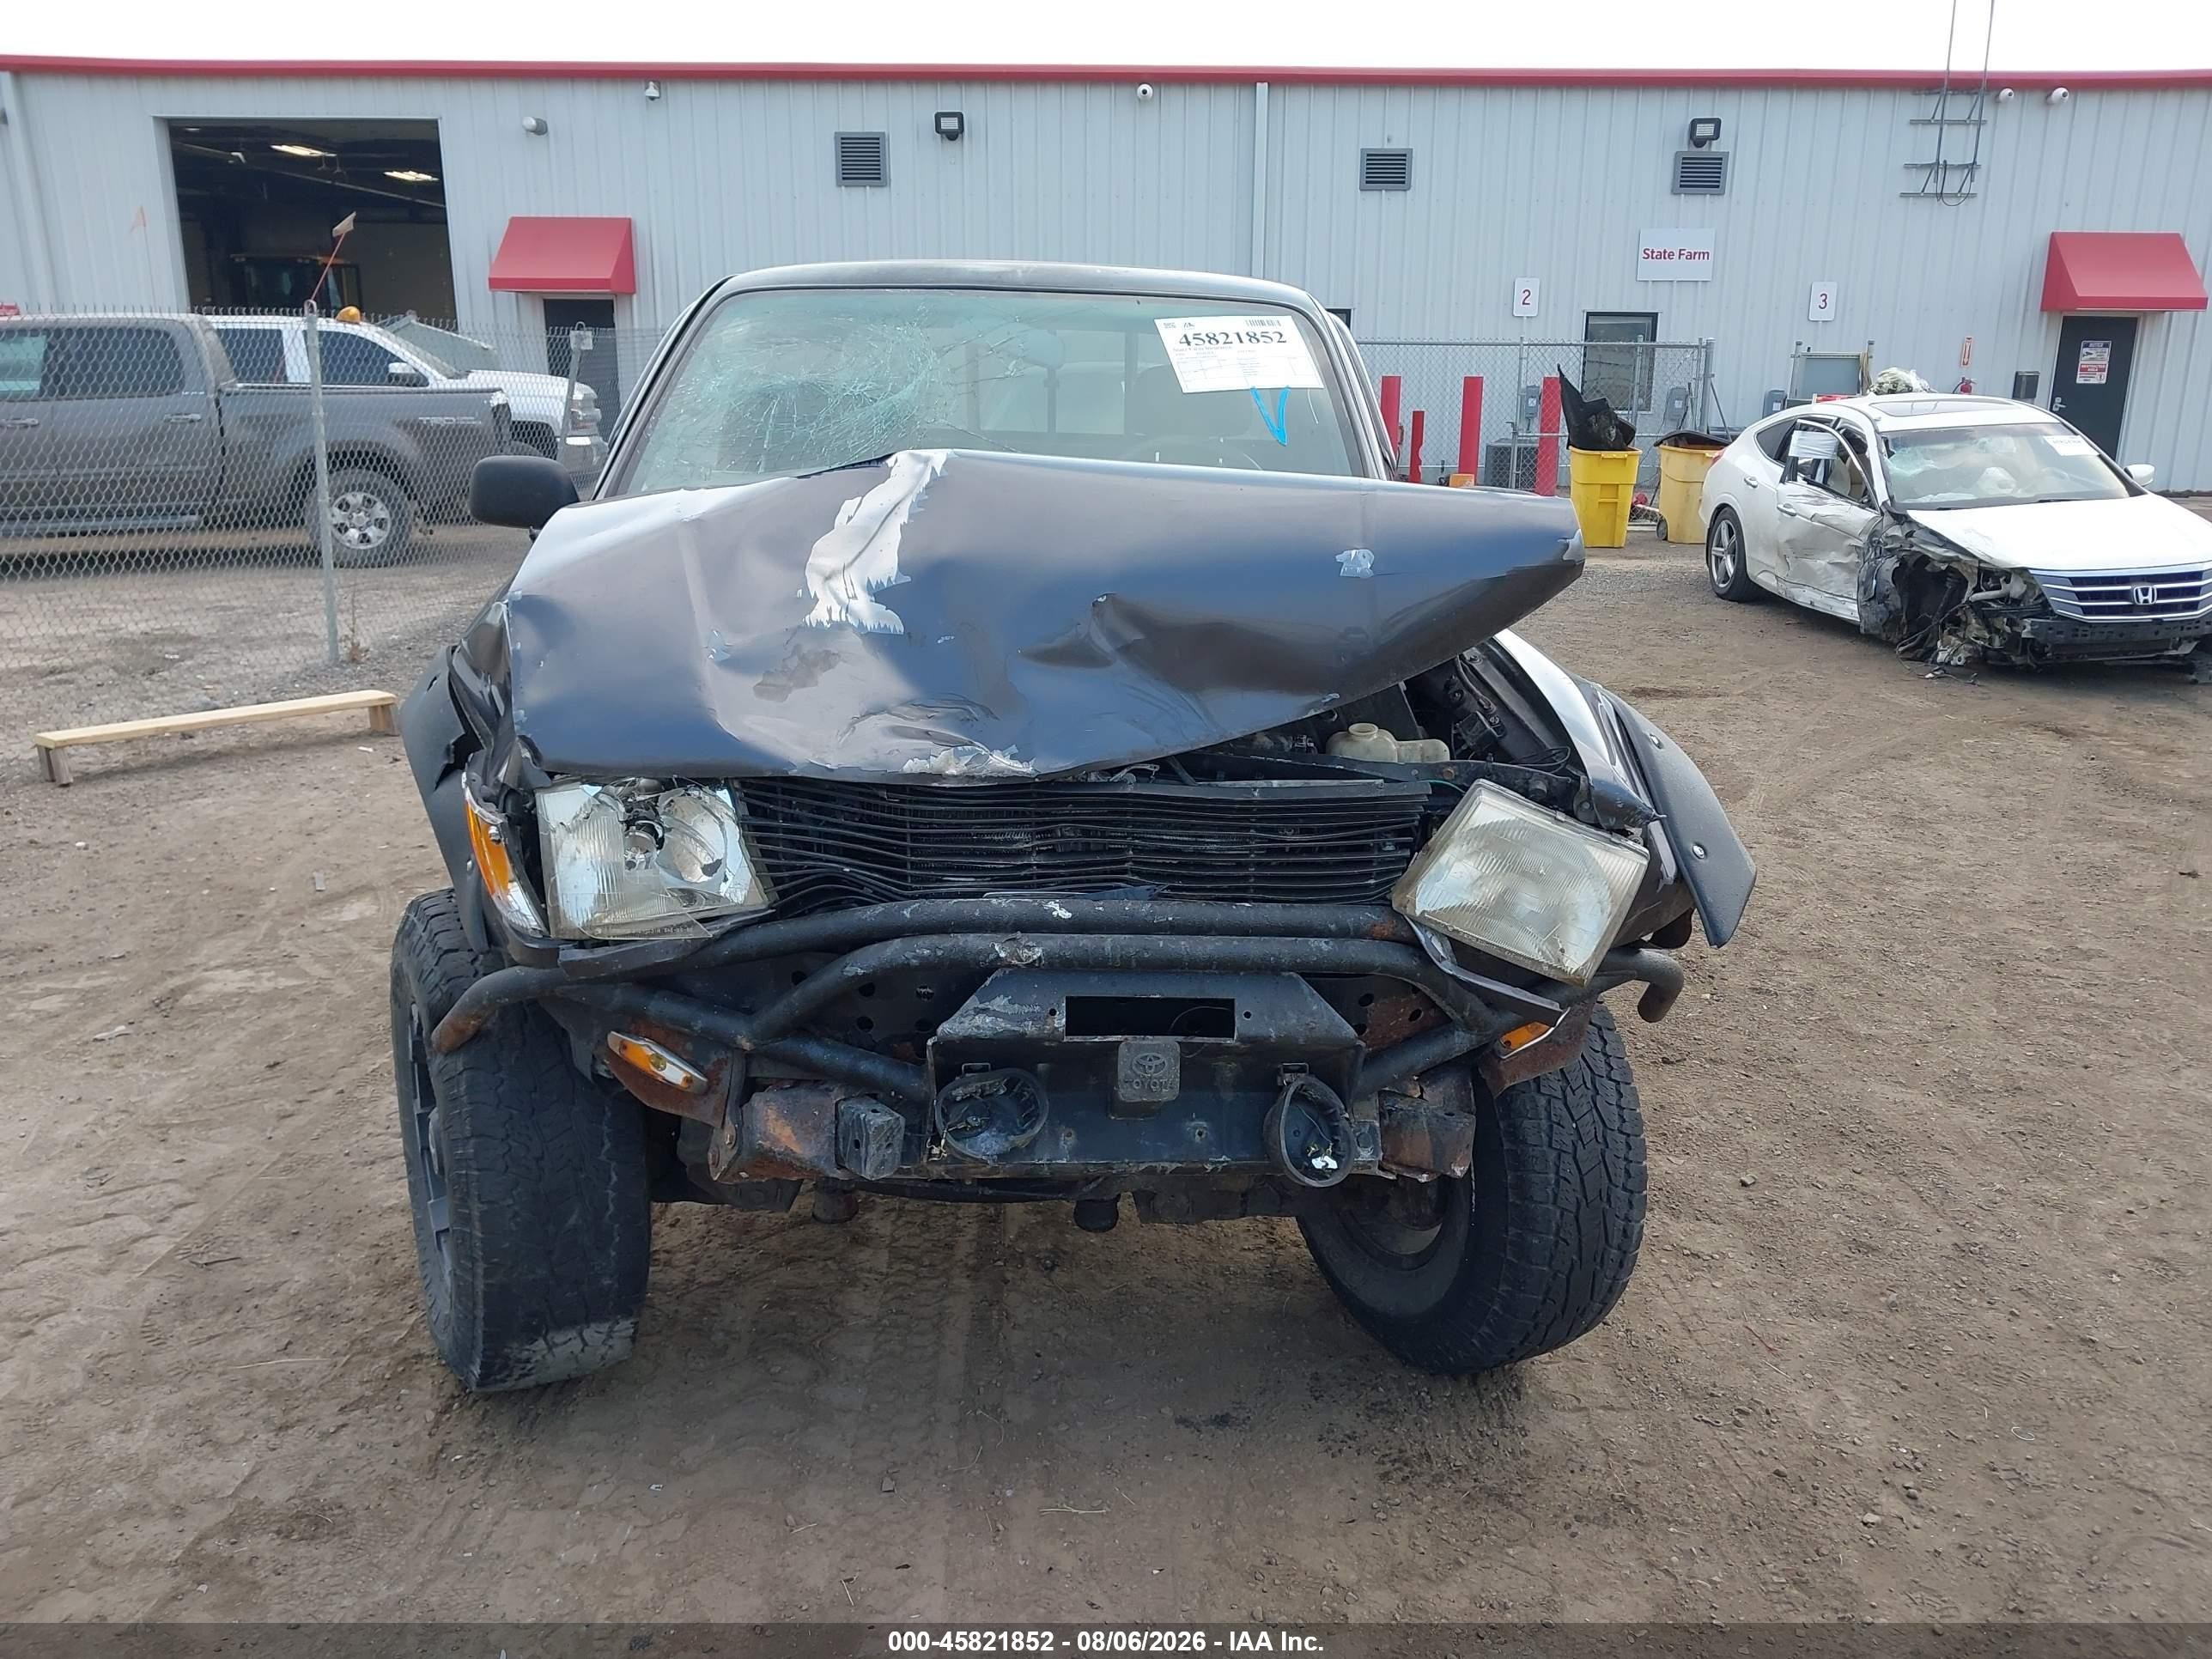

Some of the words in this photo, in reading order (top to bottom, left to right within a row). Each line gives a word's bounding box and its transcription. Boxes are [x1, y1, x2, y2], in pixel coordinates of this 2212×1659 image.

[1642, 247, 1675, 261] State
[1678, 248, 1711, 261] Farm
[1522, 289, 1531, 306] 2
[1818, 293, 1828, 310] 3
[1179, 331, 1287, 347] 45821852
